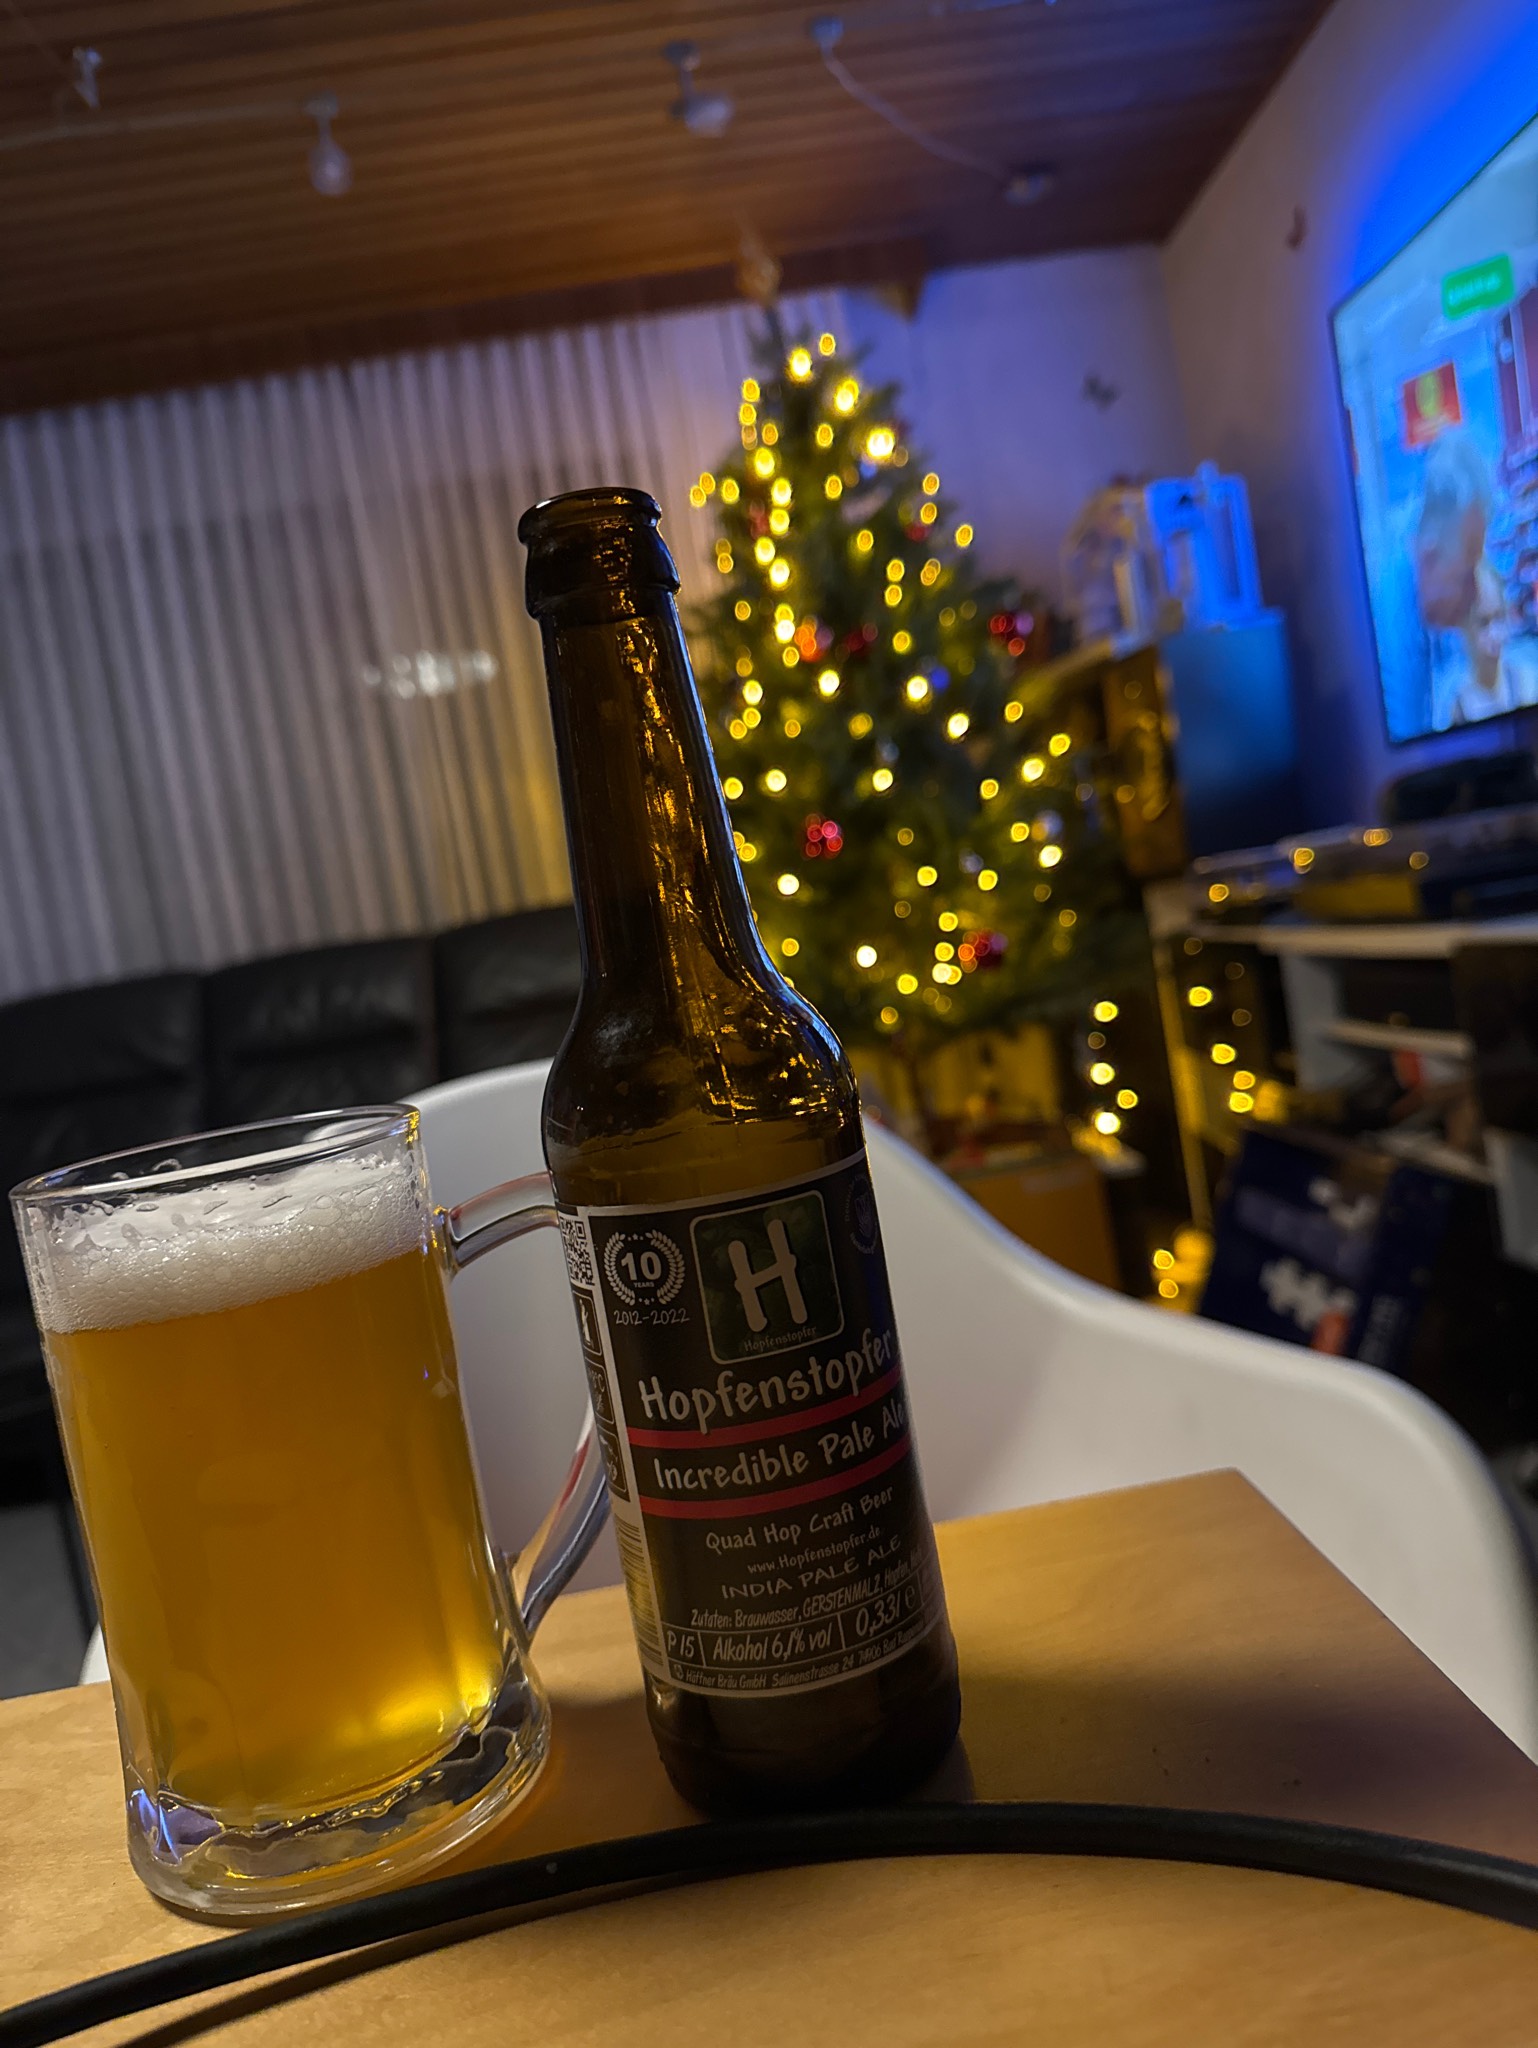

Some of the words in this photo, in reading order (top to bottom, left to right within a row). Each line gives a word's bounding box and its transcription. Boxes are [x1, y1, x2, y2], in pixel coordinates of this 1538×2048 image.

[621, 1251, 662, 1281] 10
[633, 1281, 655, 1289] YEARS
[727, 1219, 808, 1332] H
[613, 1307, 691, 1326] 2012-2022
[743, 1326, 818, 1352] Hopfenstopfer
[638, 1328, 892, 1435] Hopfenstopfer
[654, 1445, 809, 1490] Incredible
[818, 1421, 875, 1465] Pale
[706, 1527, 757, 1555] Quad
[764, 1523, 801, 1545] Hop
[809, 1502, 855, 1533] Craft
[859, 1486, 894, 1515] Beer
[721, 1578, 793, 1599] INDIA
[798, 1557, 860, 1588] PALE
[867, 1534, 901, 1566] ALE
[747, 1525, 881, 1574] www.Hopfenstopfer.de
[691, 1608, 733, 1628] Zutaten:
[713, 1634, 769, 1661] Alkohol
[771, 1627, 806, 1661] 6,1%
[808, 1622, 833, 1652] vol
[740, 1673, 767, 1689] GmbH
